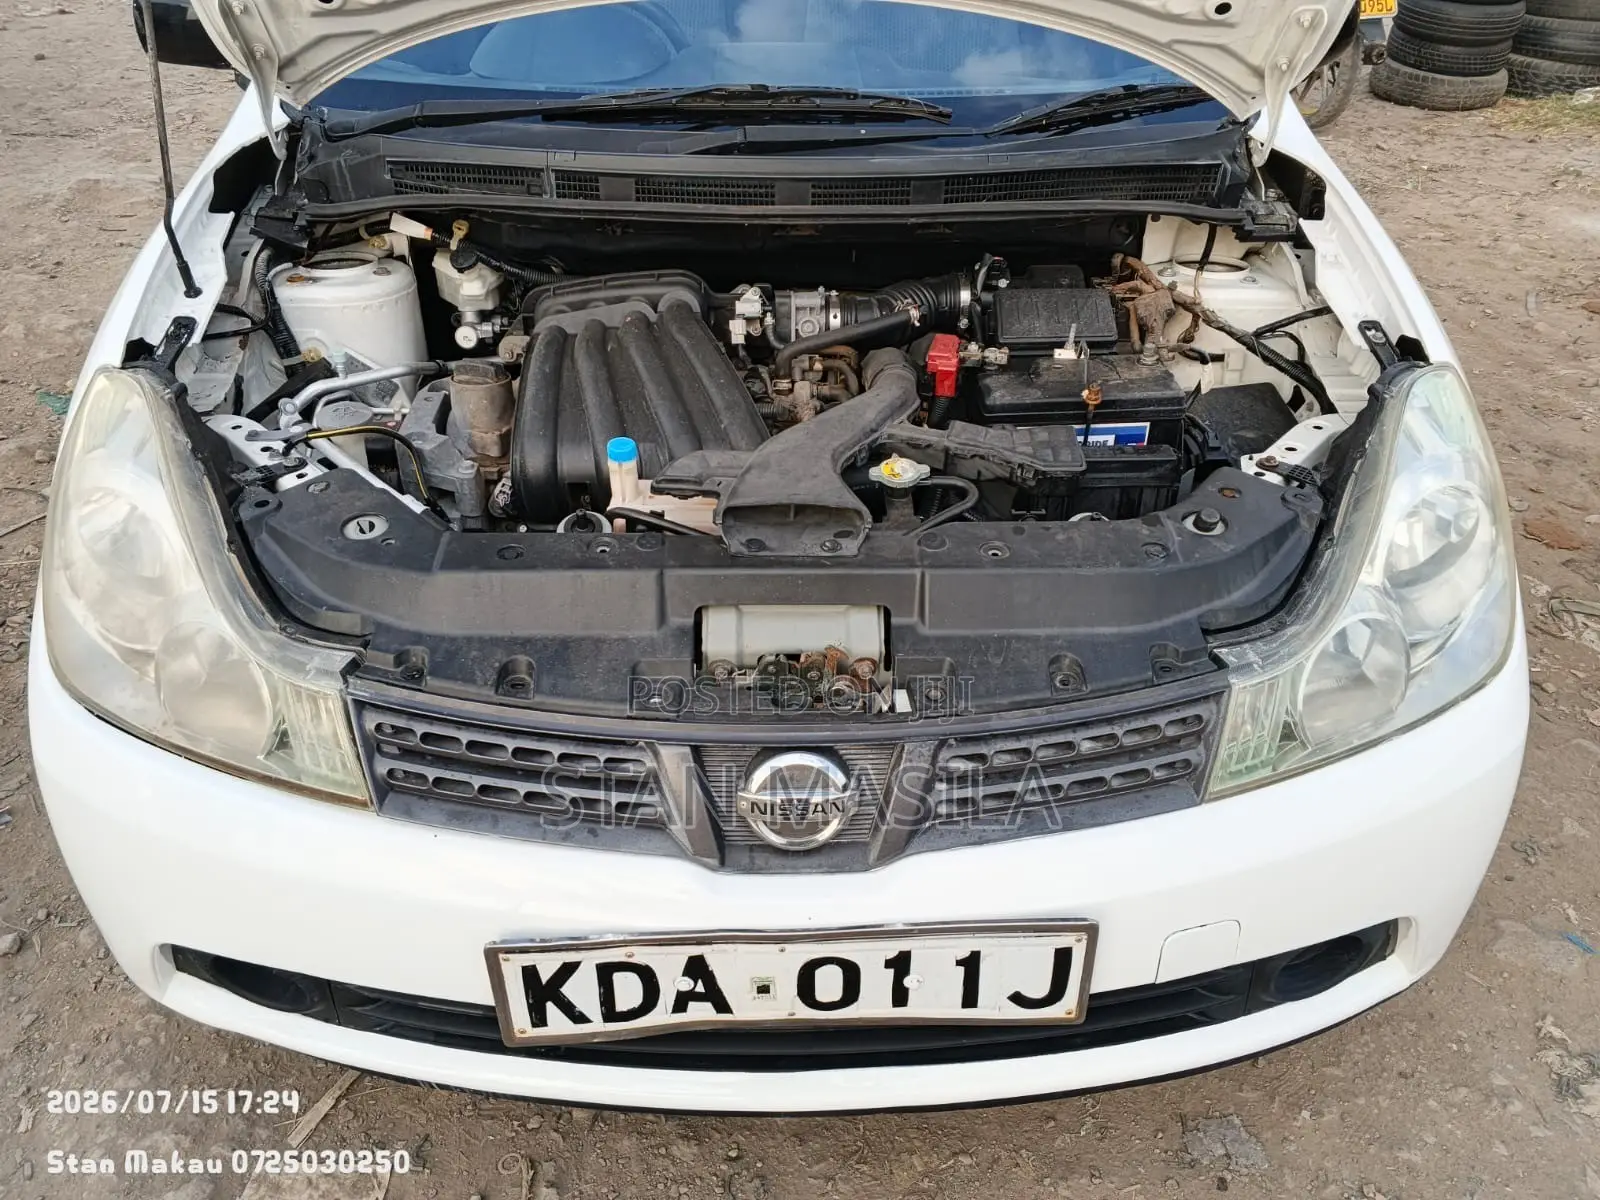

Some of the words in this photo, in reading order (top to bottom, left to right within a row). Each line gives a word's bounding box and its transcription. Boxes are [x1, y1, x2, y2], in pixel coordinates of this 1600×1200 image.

[750, 800, 845, 817] NISSAN
[521, 954, 734, 1028] KDA
[796, 946, 1074, 1012] 011J
